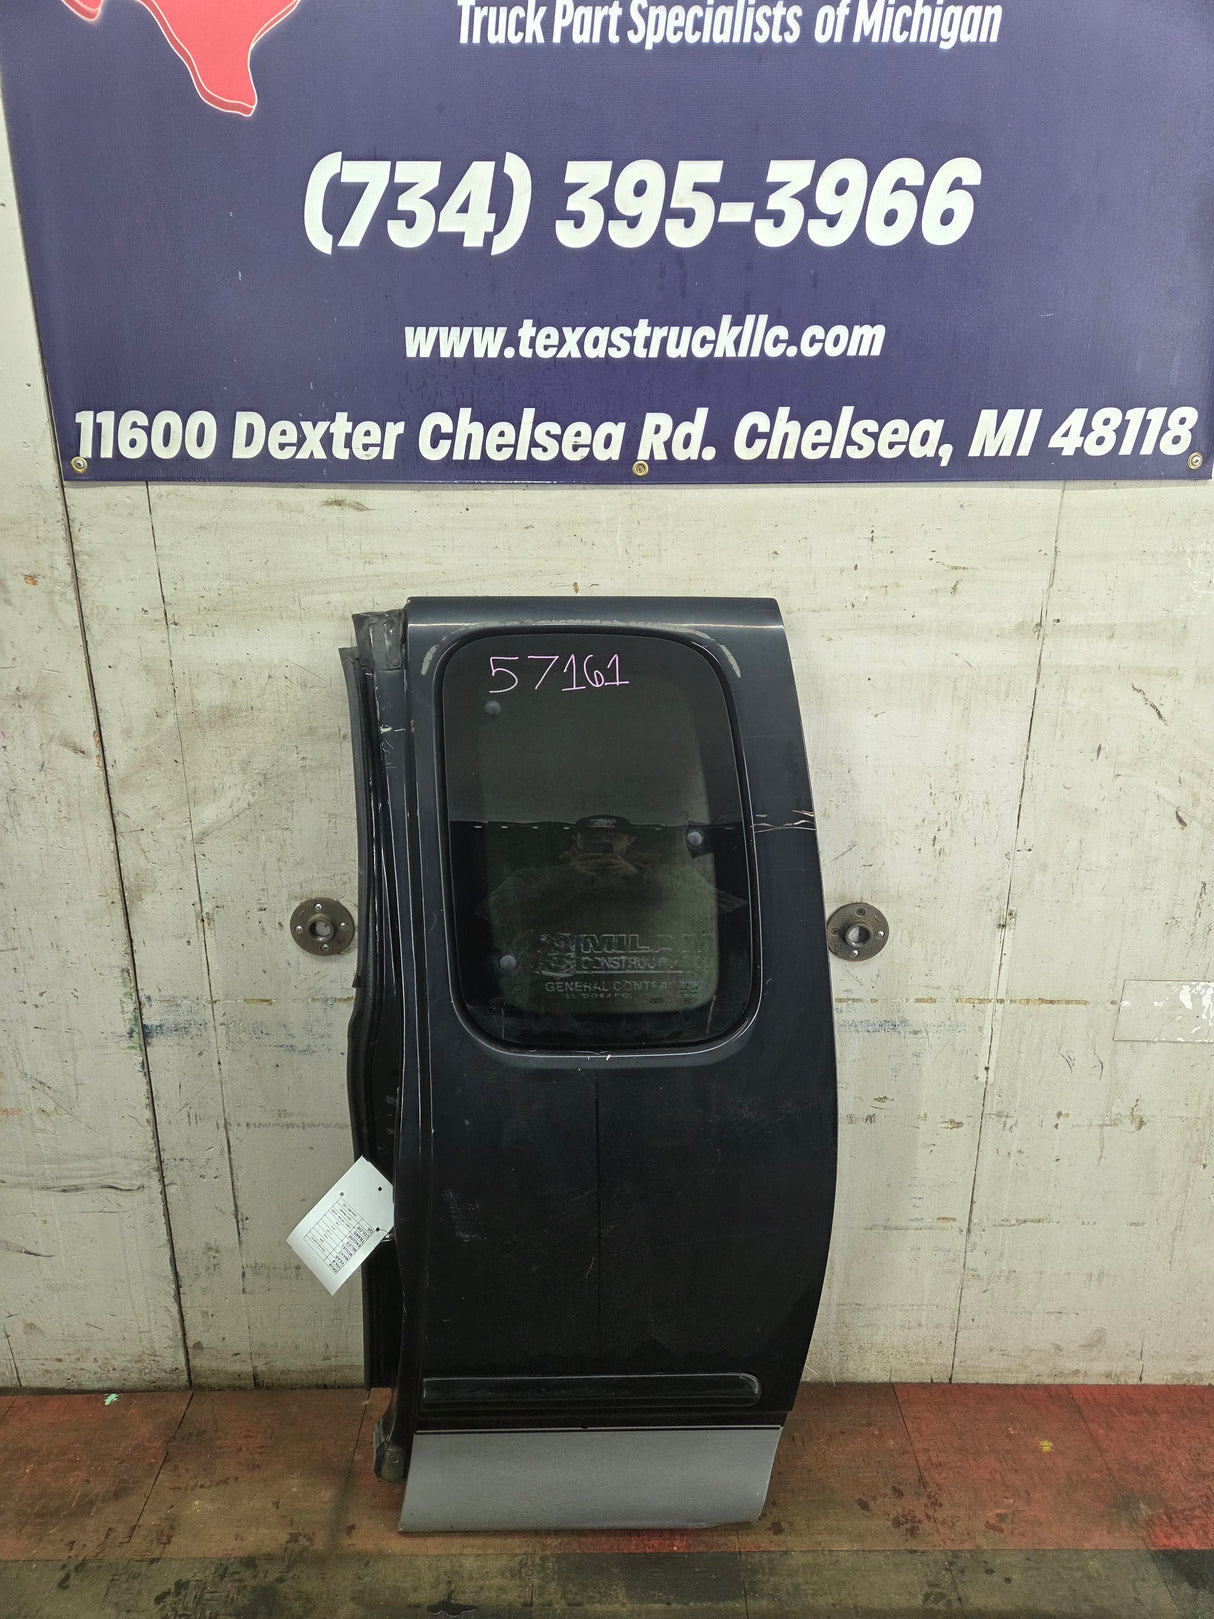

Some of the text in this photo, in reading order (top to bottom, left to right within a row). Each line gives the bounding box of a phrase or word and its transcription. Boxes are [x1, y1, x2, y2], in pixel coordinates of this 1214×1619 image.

[457, 0, 1003, 50] Truck Part Specialists of Michigan
[303, 151, 983, 256] (734) 395-3966
[404, 314, 887, 359] www.texastruckllc.com
[75, 405, 1199, 467] 11600 Dexter Chelsea Rd. Chelsea, MI 48118
[489, 653, 630, 693] 57161
